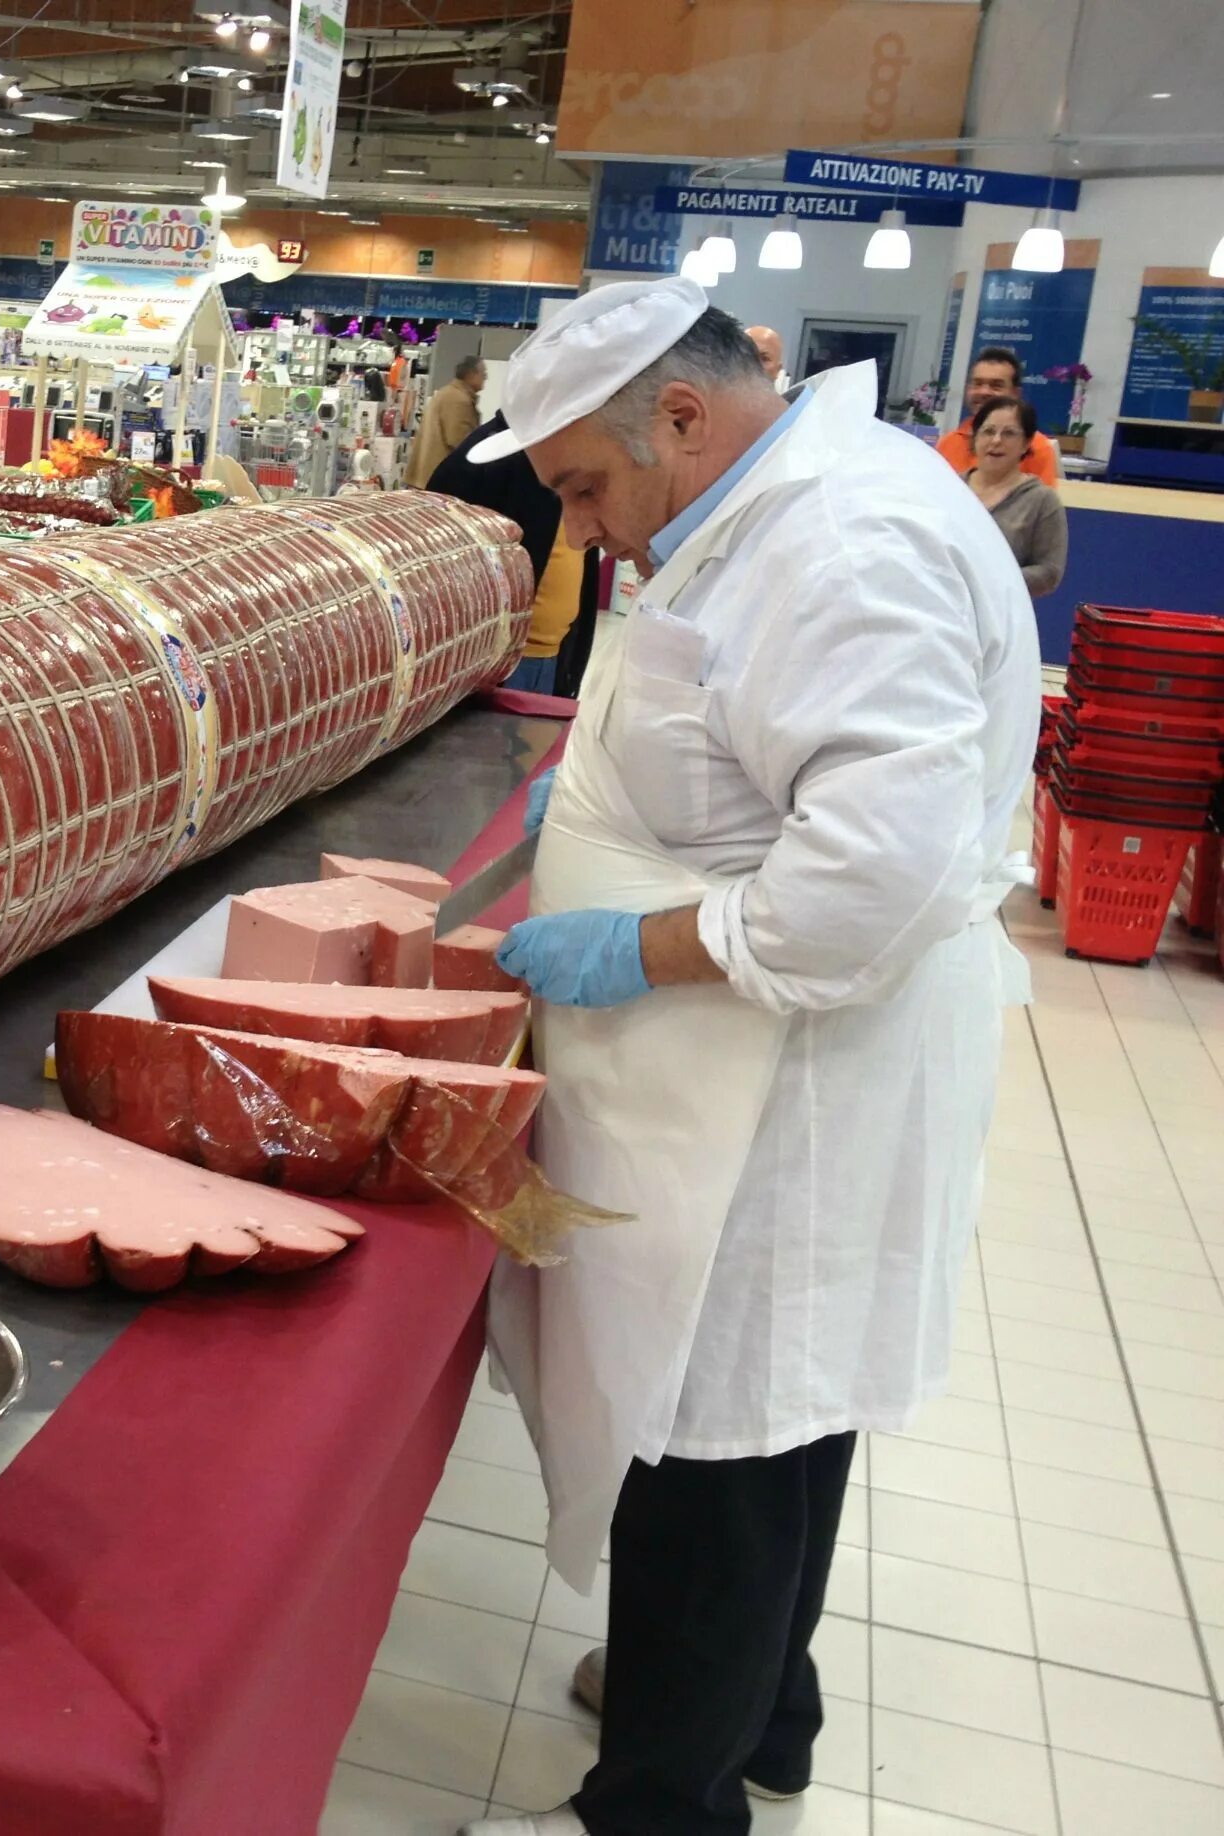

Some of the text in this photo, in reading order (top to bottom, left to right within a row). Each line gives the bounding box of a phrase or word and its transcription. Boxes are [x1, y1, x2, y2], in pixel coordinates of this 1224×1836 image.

[810, 157, 984, 195] ATTIVAZIONE PAY-TV
[677, 191, 858, 217] PAGAMENTI RATEALI
[87, 220, 200, 250] VITAMINI
[279, 242, 302, 260] 93
